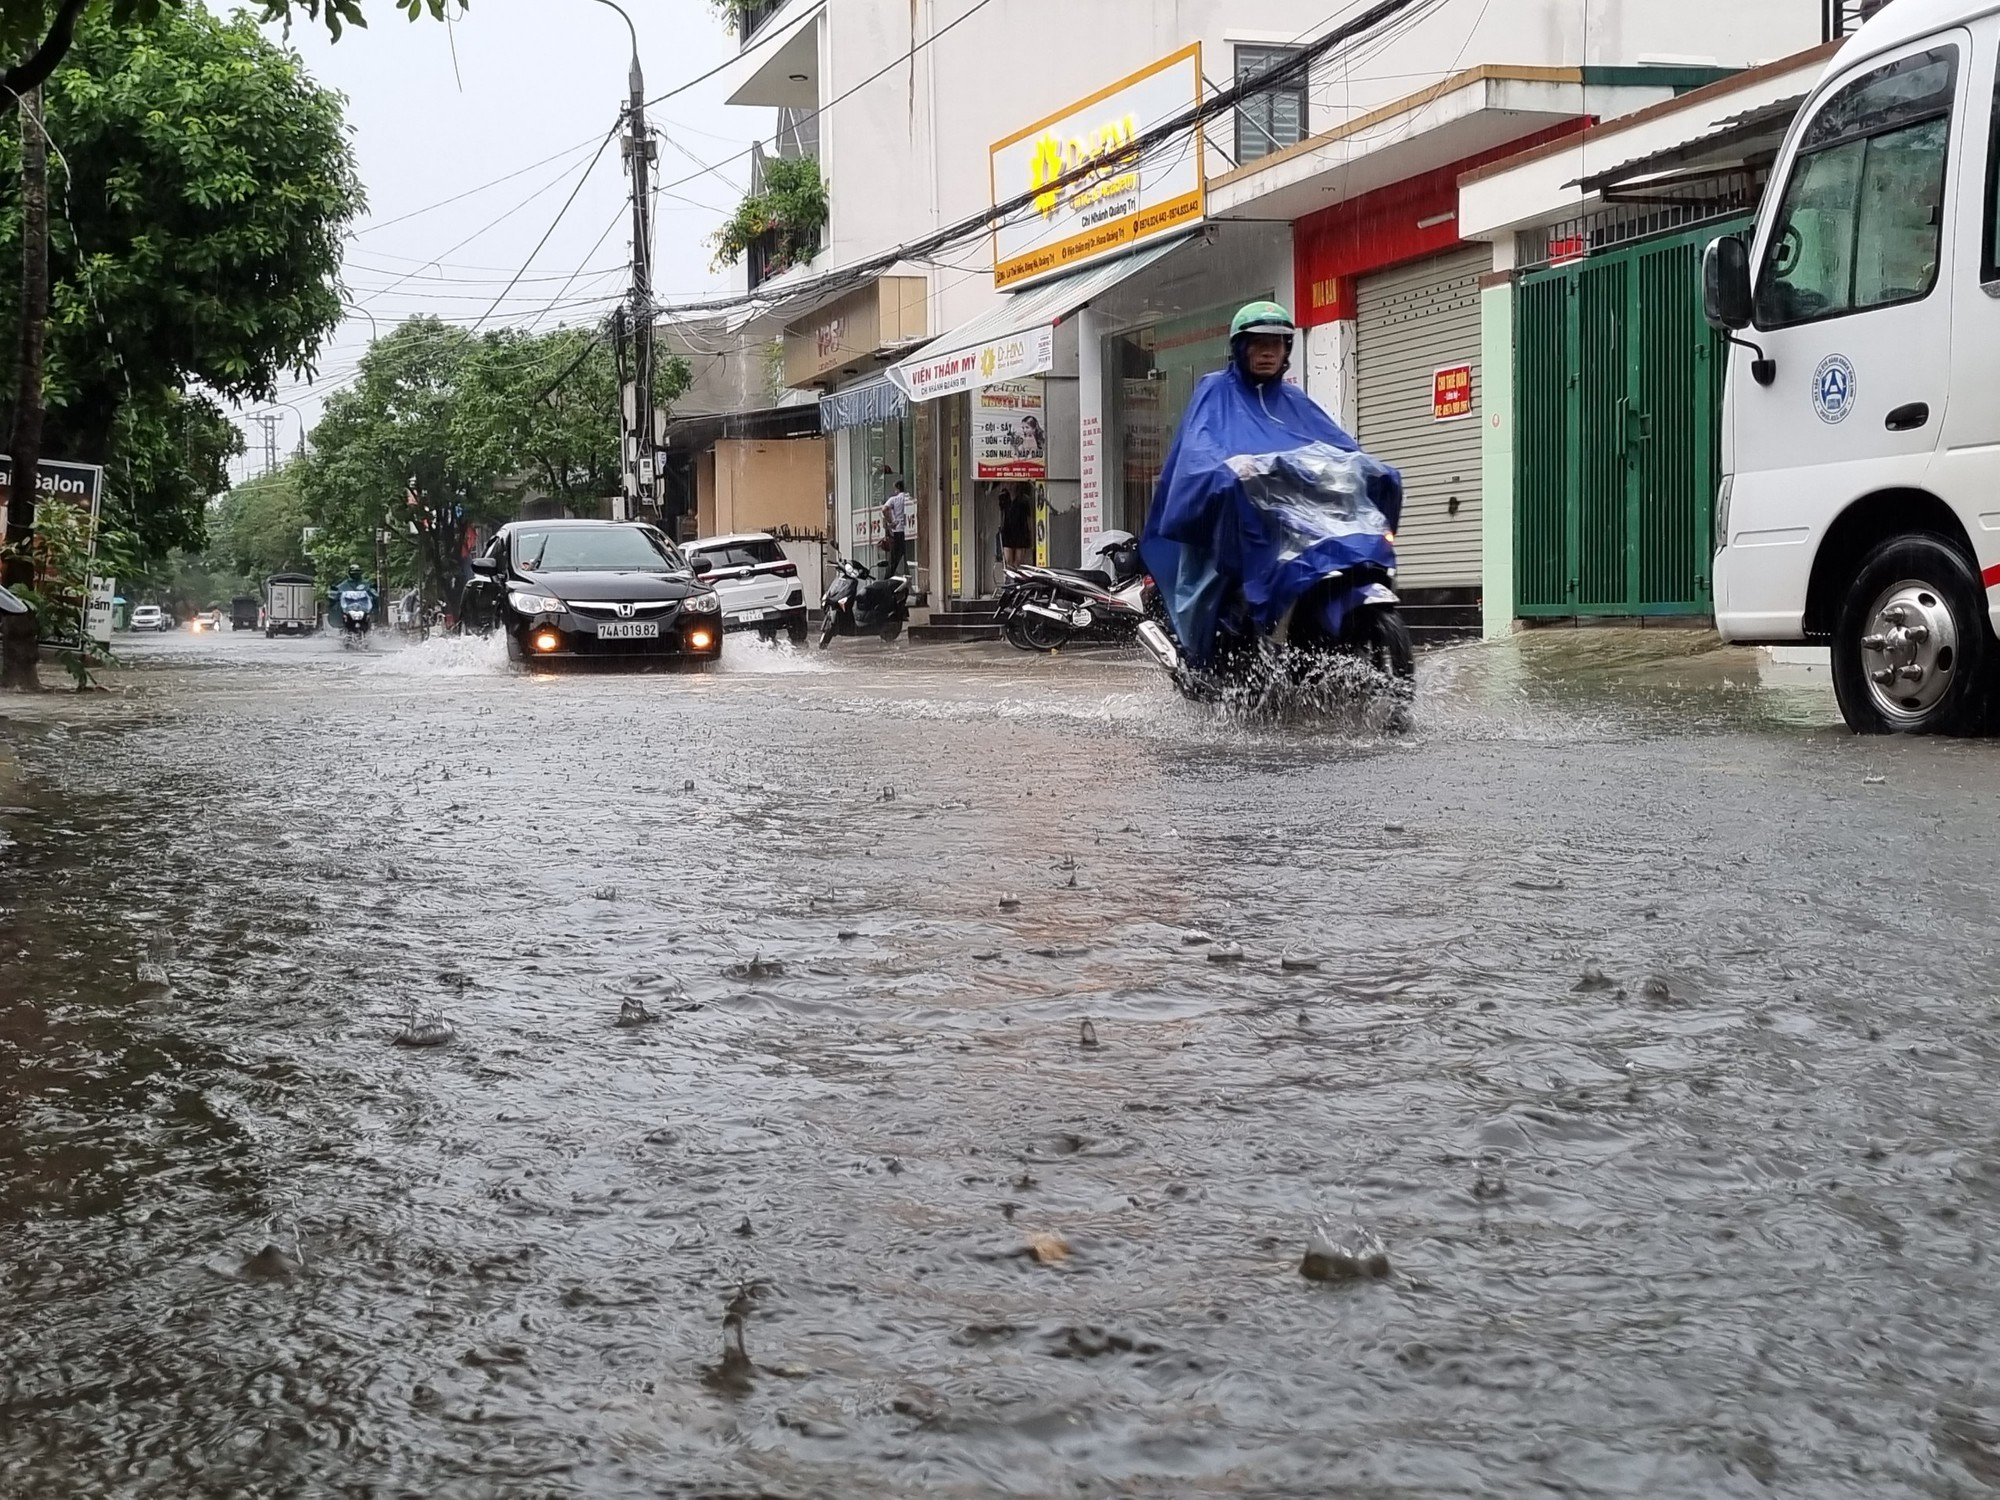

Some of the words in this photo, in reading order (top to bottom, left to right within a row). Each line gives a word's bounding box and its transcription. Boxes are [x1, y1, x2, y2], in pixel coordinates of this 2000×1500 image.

[1081, 212, 1090, 228] Chi
[1091, 207, 1108, 225] Nhánh
[1109, 201, 1127, 218] Quảng
[1127, 196, 1137, 212] Trị
[912, 366, 932, 387] VIỆN
[933, 356, 959, 380] THẨM
[961, 352, 977, 376] MỸ
[928, 381, 944, 394] NHÁNH
[985, 422, 995, 433] GỘI
[1000, 421, 1012, 432] SẤY
[985, 449, 999, 458] SƠN
[999, 449, 1012, 458] NAIL
[0, 469, 12, 486] ai
[907, 513, 916, 529] VP
[599, 623, 657, 638] 74A-019.82
